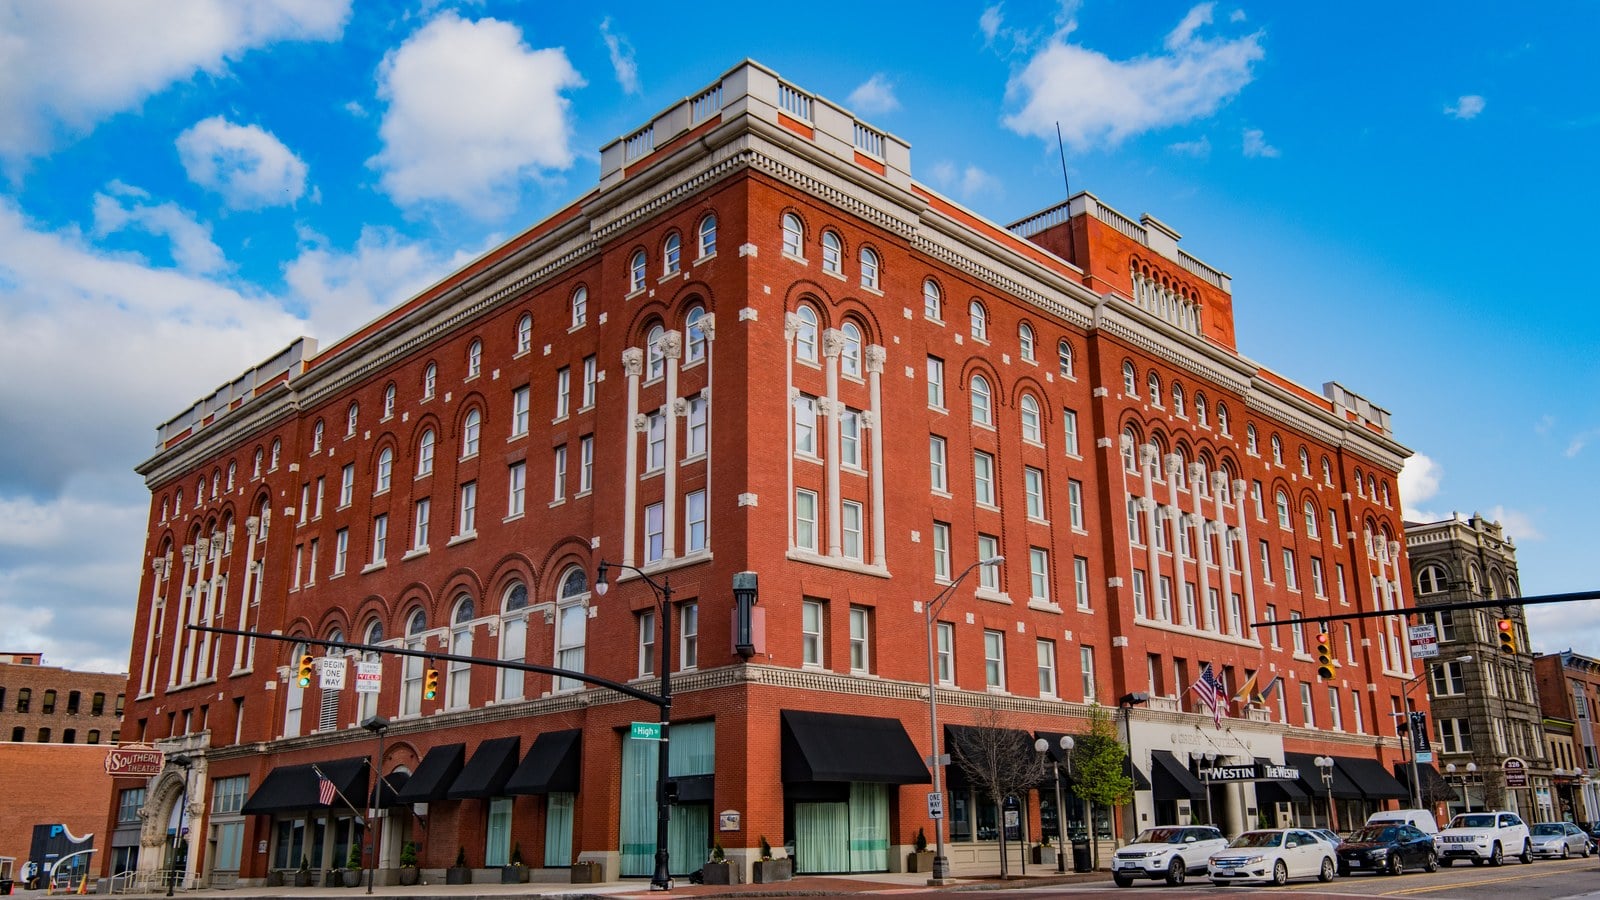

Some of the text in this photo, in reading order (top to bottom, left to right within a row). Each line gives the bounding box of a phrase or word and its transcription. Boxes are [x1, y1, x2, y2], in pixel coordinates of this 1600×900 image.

[323, 660, 345, 669] BEGIN
[326, 669, 341, 678] ONE
[637, 726, 654, 738] High
[111, 753, 160, 771] SOUTHERN
[128, 764, 161, 773] THEATRE
[1212, 767, 1255, 780] WESTIN
[1265, 765, 1300, 779] THE WESTIN
[50, 825, 63, 838] P
